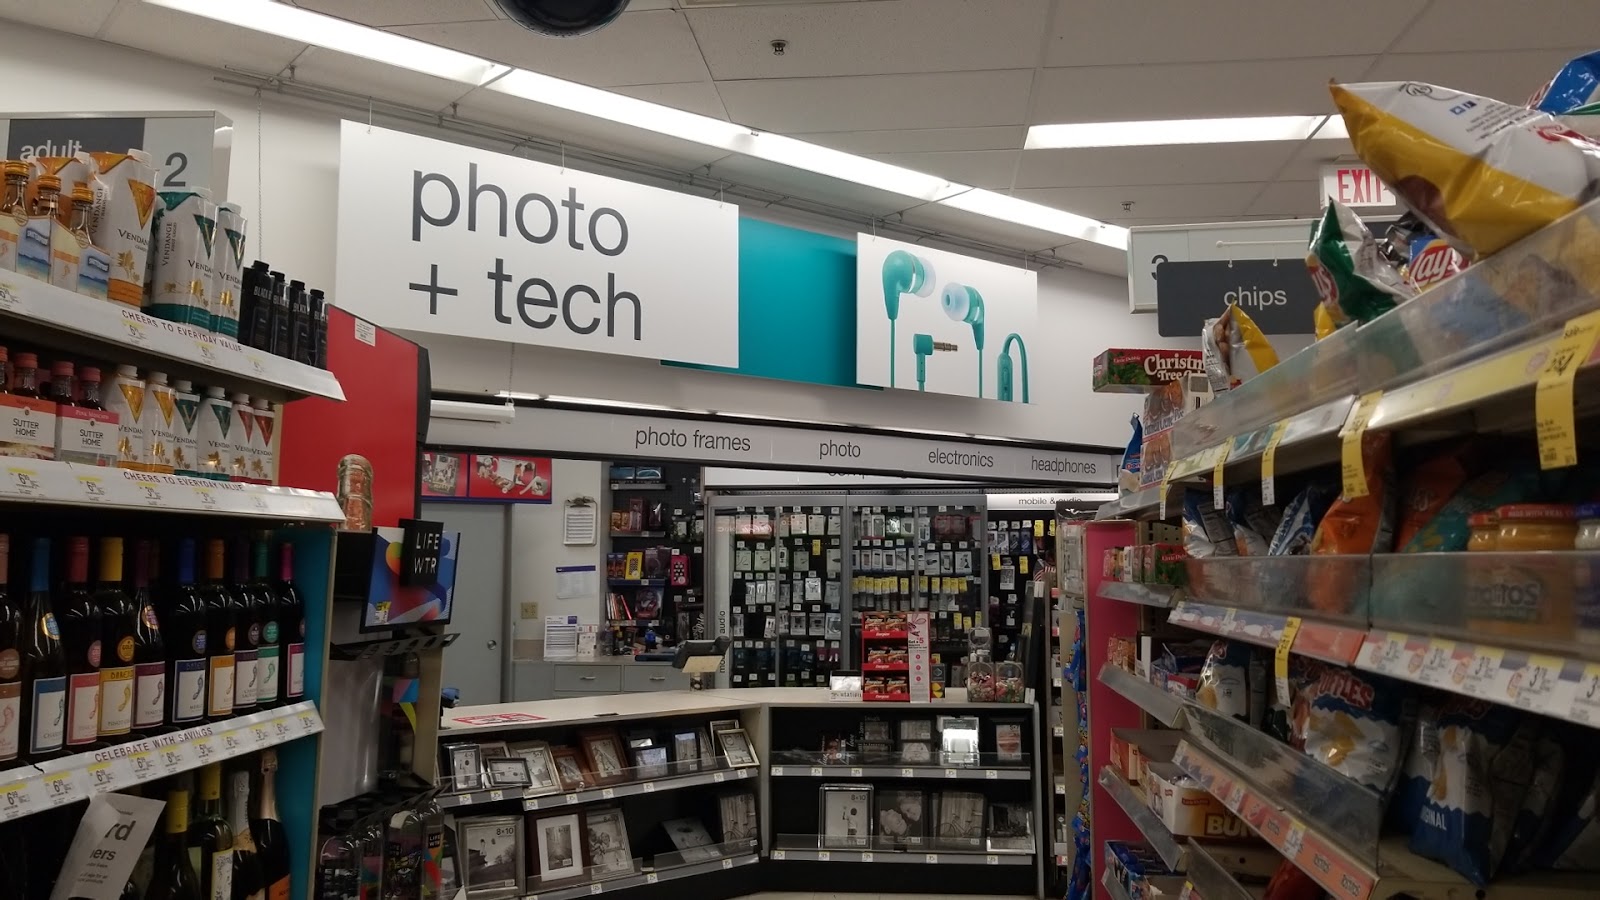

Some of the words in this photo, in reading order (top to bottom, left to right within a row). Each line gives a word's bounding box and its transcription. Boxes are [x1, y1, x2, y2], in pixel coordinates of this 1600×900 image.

[20, 139, 83, 161] adult
[163, 152, 188, 187] 2
[412, 162, 629, 257] photo
[161, 222, 173, 267] VENDANGE
[487, 258, 642, 341] tech
[1223, 284, 1288, 312] chips
[121, 309, 159, 329] CHEERS
[161, 321, 175, 333] TO
[177, 327, 218, 346] EVERYDAY
[218, 338, 243, 354] VALUE
[1156, 370, 1182, 382] Tree
[12, 417, 40, 430] SUTTER
[15, 428, 37, 438] HOME
[79, 428, 104, 439] SUTTER
[81, 437, 102, 447] HOME
[635, 425, 688, 449] photo
[693, 427, 751, 452] frames
[818, 439, 861, 461] photo
[928, 448, 995, 469] electronics
[1031, 455, 1097, 475] headphones
[123, 471, 161, 483] CHEERS
[163, 475, 176, 485] TO
[178, 477, 219, 490] EVERYDAY
[219, 482, 245, 492] VALUE
[1018, 496, 1048, 505] mobile
[1049, 497, 1056, 505] &
[415, 531, 441, 550] LIFE
[413, 555, 438, 576] WTR
[94, 741, 150, 763] CELEBRATE
[152, 735, 176, 749] WITH
[178, 727, 214, 743] SAVINGS
